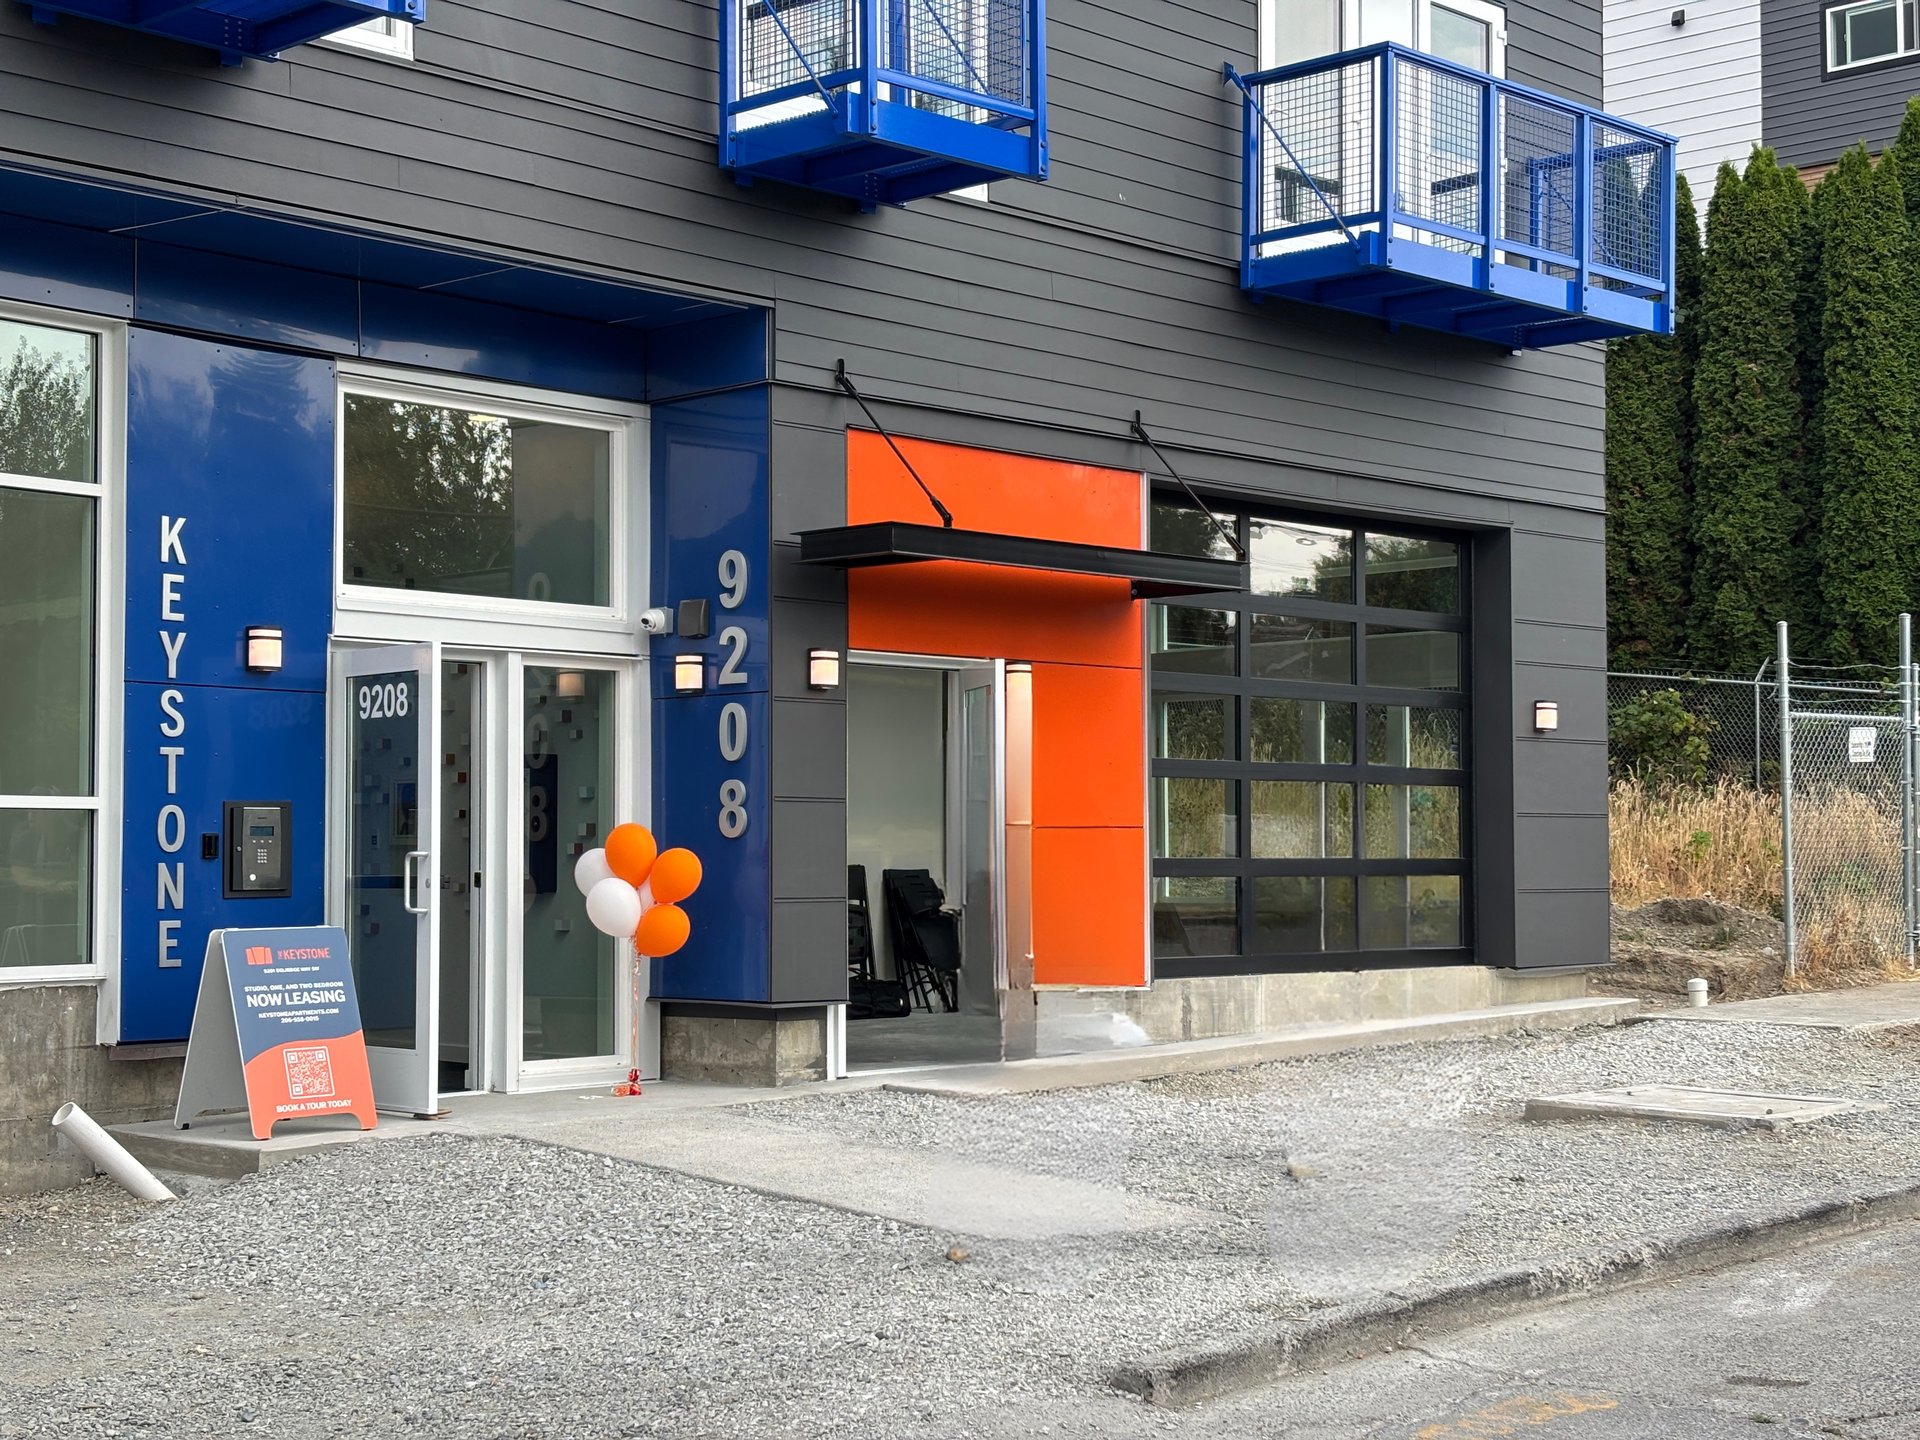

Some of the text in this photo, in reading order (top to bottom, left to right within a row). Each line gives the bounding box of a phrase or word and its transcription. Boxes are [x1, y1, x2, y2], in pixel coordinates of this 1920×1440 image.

[359, 682, 408, 720] 9208
[717, 549, 749, 838] 9208
[157, 515, 187, 968] KEYSTONE
[284, 947, 331, 960] KEYSTONE
[244, 984, 270, 992] STUDIO,
[313, 981, 344, 989] BEDROOM
[246, 989, 346, 1008] NOW LEASING
[258, 1008, 339, 1019] KEYSTONEAPARTMENTS.COM
[276, 1104, 299, 1113] BOOK
[305, 1102, 327, 1110] TOUR
[327, 1099, 352, 1108] TODAY
